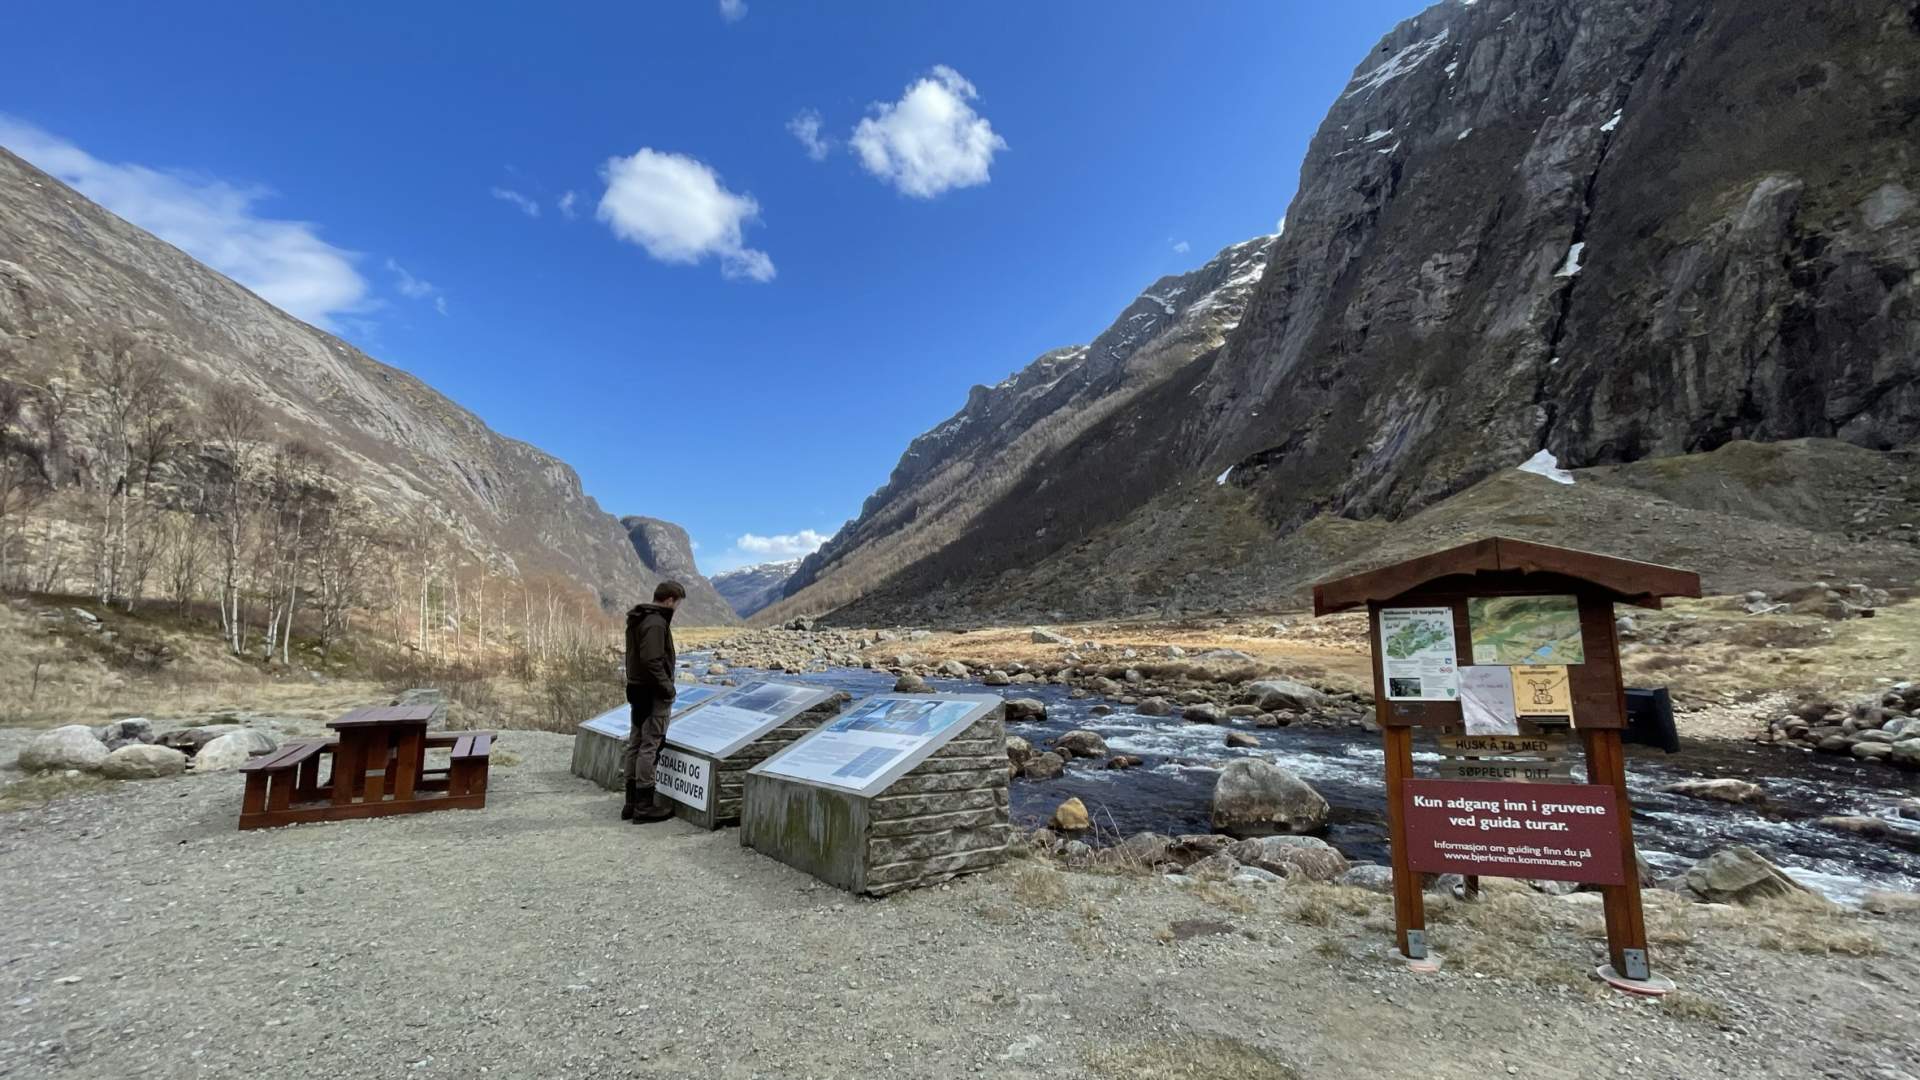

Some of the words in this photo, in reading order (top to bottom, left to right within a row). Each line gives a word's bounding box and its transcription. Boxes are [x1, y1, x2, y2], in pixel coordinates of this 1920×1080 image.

[1456, 741, 1488, 750] HUSK
[1489, 737, 1498, 750] Å
[1502, 741, 1516, 750] TA
[1521, 741, 1548, 751] MED
[689, 763, 700, 779] OG
[1458, 767, 1517, 778] SØPPELET
[1525, 768, 1550, 779] DITT
[675, 778, 704, 800] GRUVER
[1414, 796, 1443, 808] Kun
[1447, 797, 1500, 813] adgang
[1504, 800, 1528, 811] inn
[1532, 800, 1537, 812] i
[1541, 803, 1606, 815] gruvene
[1449, 815, 1476, 827] ved
[1480, 816, 1521, 830] guida
[1525, 818, 1569, 832] turar.
[1434, 840, 1487, 852] Informasjon
[1490, 845, 1505, 853] om
[1507, 845, 1541, 856] guiding
[1543, 846, 1562, 856] finn
[1564, 847, 1577, 857] du
[1579, 848, 1592, 859] på
[1444, 851, 1583, 868] www.bjerkreim.kommune.no
